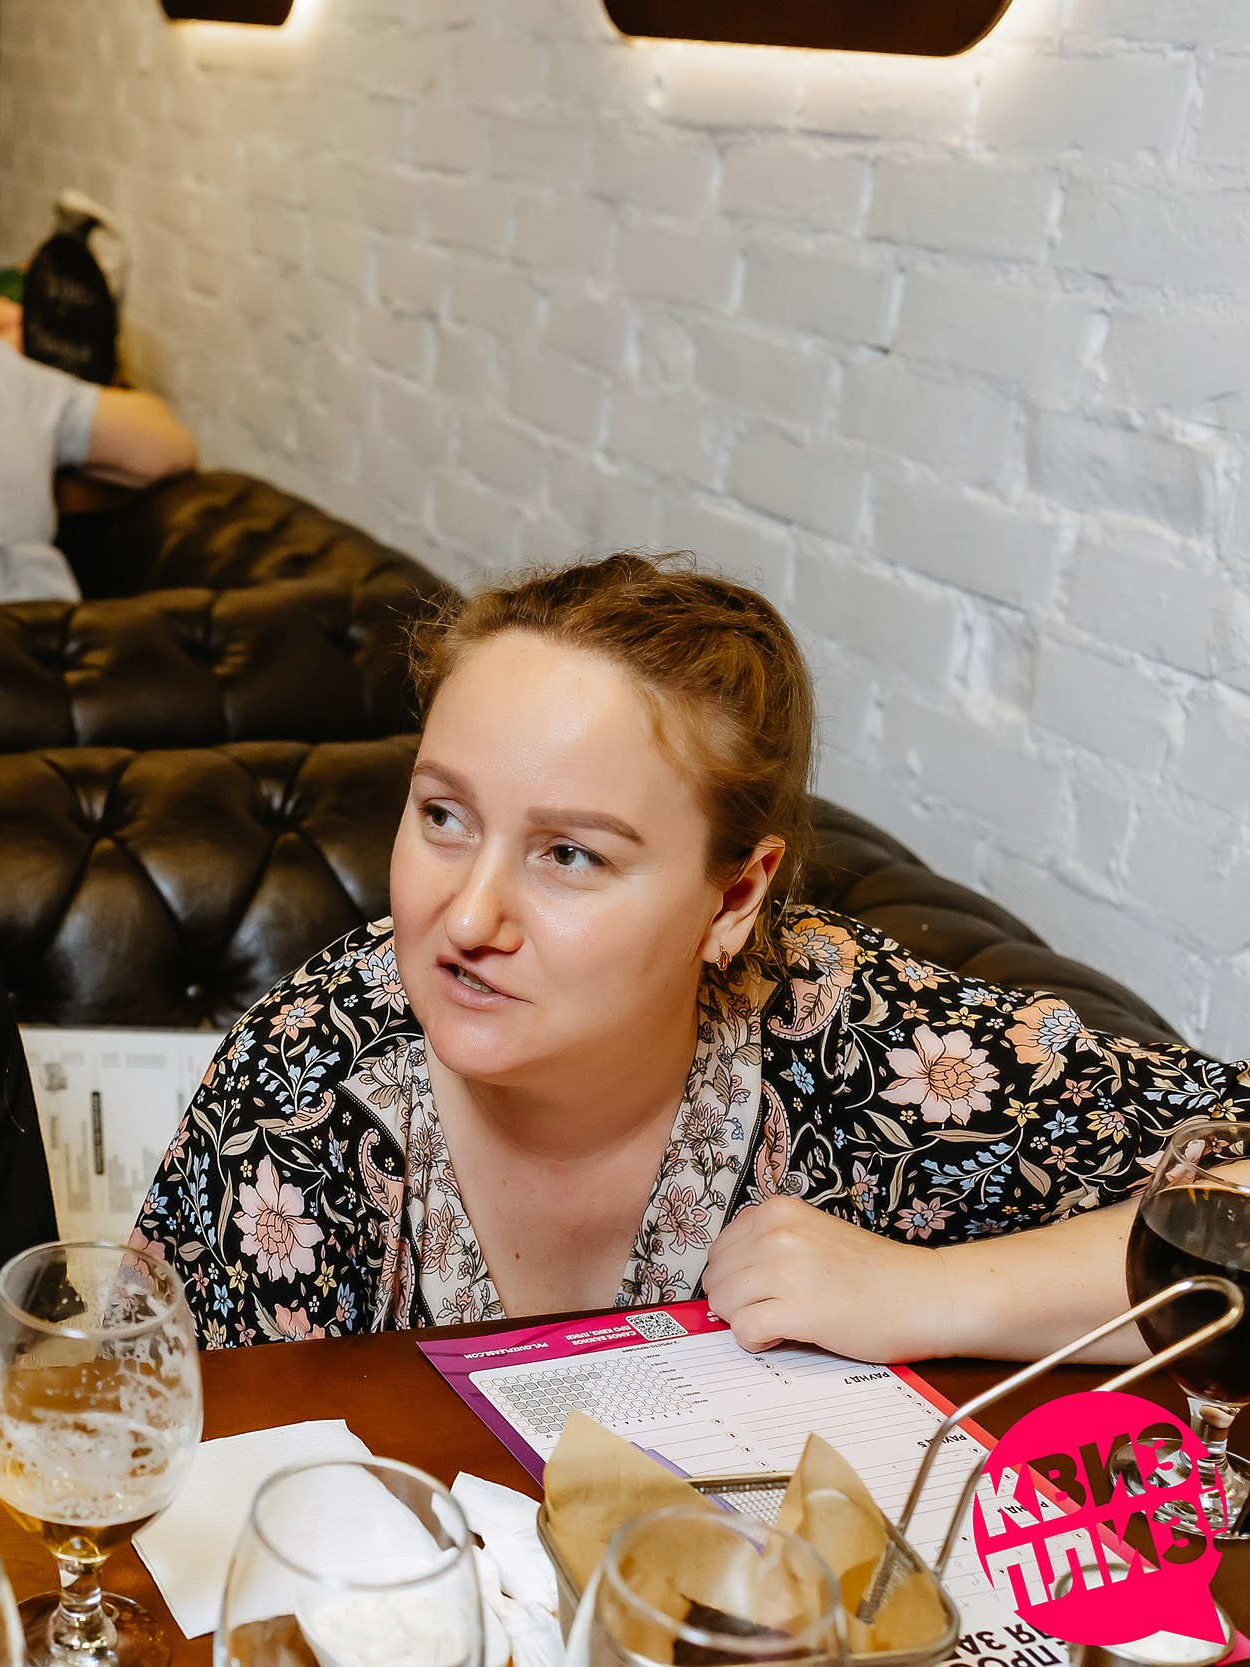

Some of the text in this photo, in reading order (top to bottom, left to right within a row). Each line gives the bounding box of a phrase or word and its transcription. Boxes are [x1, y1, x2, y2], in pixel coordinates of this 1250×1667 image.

[571, 1330, 637, 1346] САМОЕ ВАЖНОЕ
[849, 1371, 891, 1382] РАУНД
